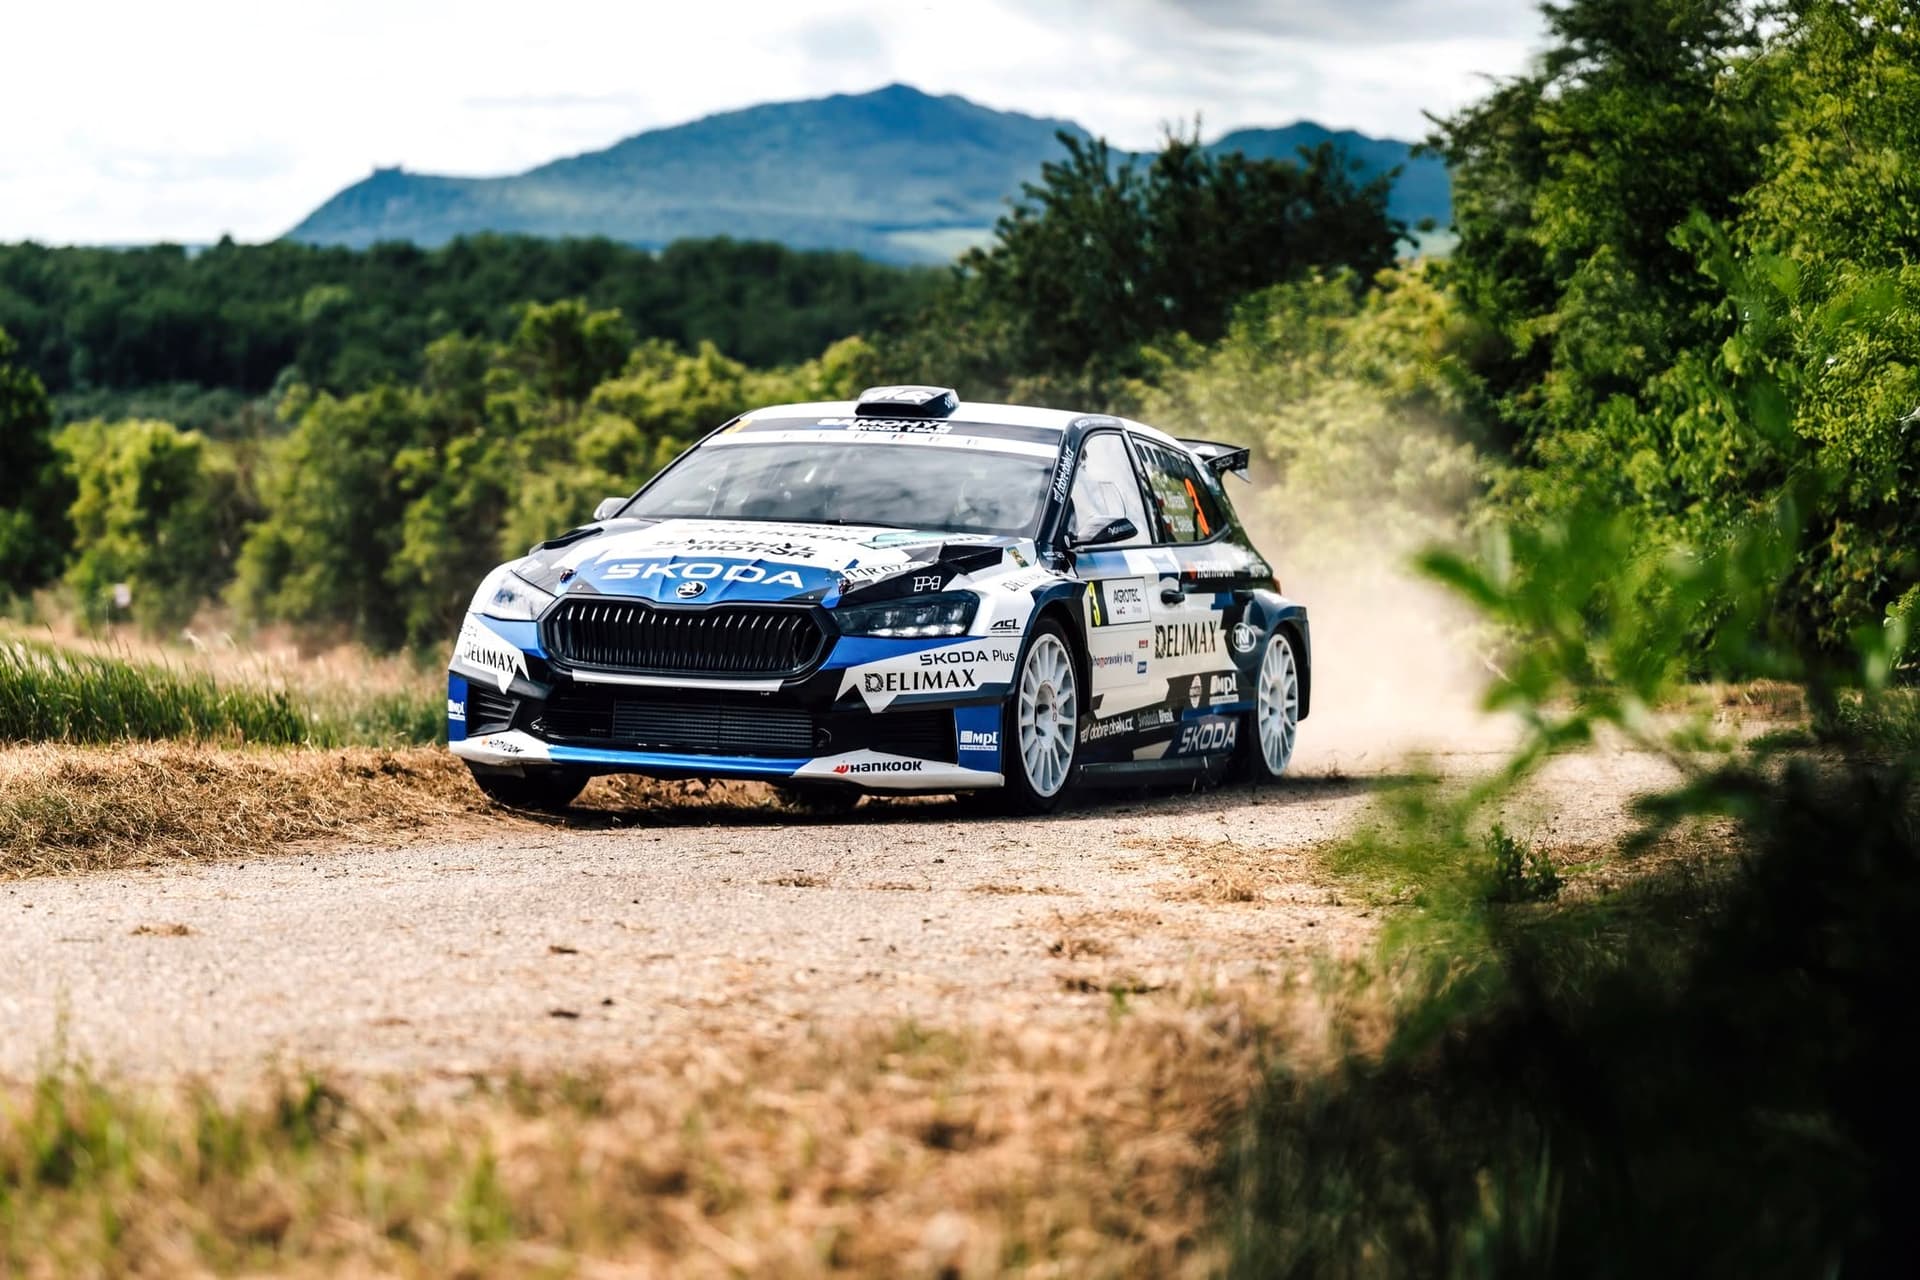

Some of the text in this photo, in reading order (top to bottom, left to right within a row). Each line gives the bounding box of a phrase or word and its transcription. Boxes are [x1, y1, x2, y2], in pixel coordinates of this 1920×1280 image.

[1088, 582, 1101, 627] 3
[1113, 588, 1141, 604] AGROTEC
[1155, 620, 1217, 660] DELIMAX
[992, 649, 1016, 662] Plus
[864, 669, 977, 693] DELIMAX
